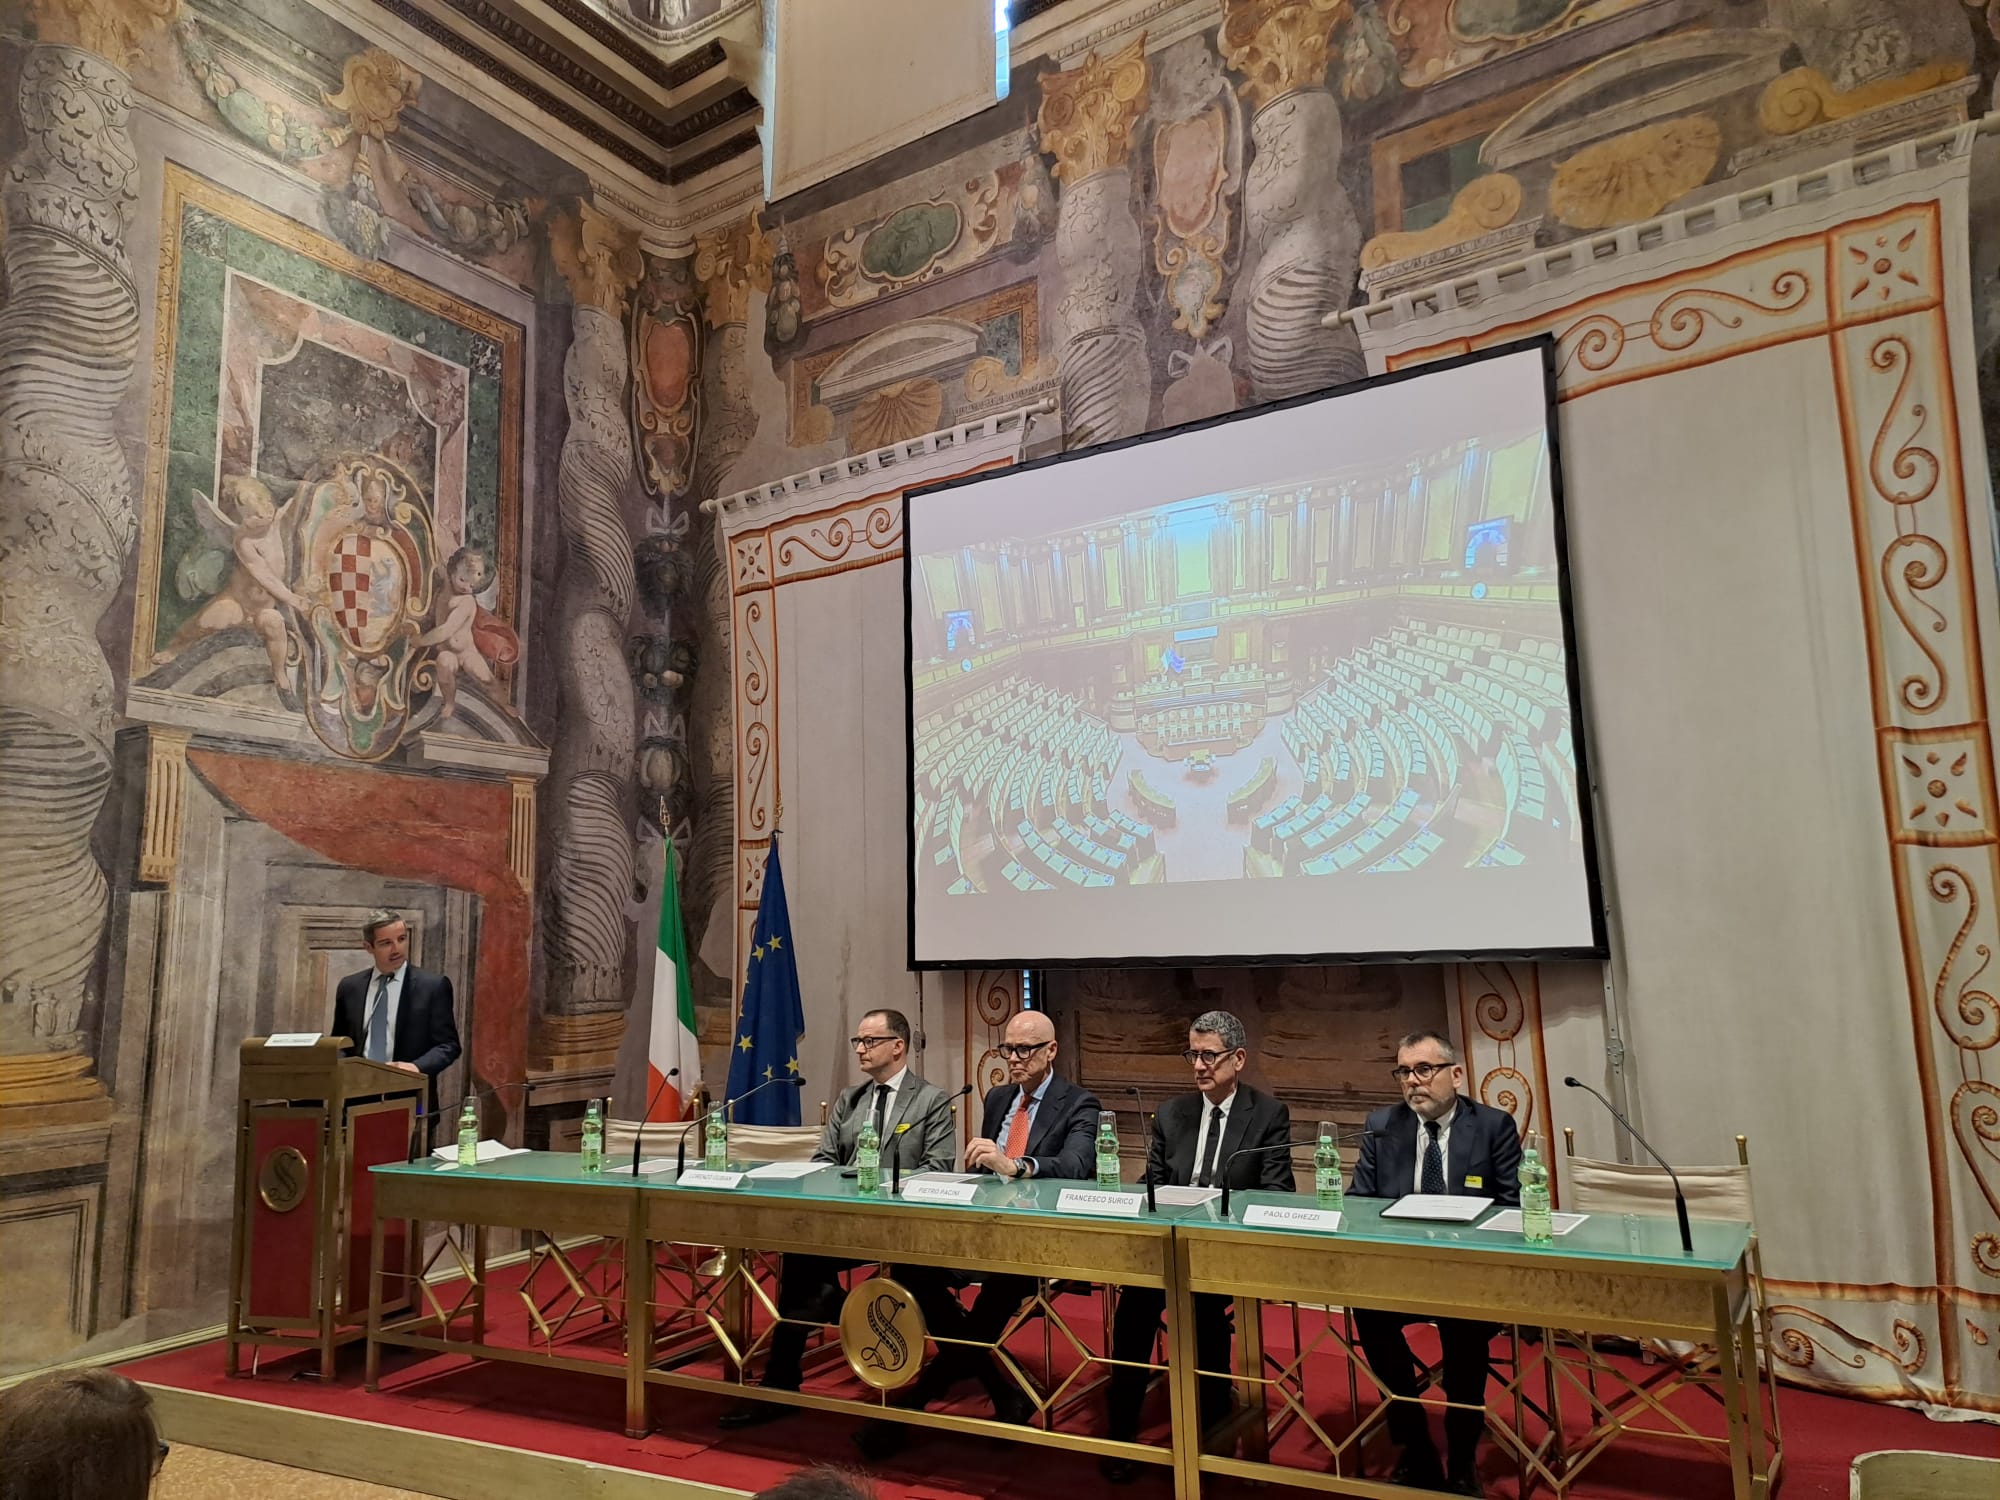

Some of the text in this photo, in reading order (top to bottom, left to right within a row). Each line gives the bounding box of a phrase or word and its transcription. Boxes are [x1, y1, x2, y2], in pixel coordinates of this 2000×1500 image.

[918, 1186, 939, 1195] PIETRO
[1064, 1193, 1134, 1205] FRANCESCO SURICO
[1263, 1210, 1321, 1221] PAOLO GHEZZI
[860, 1294, 908, 1372] S
